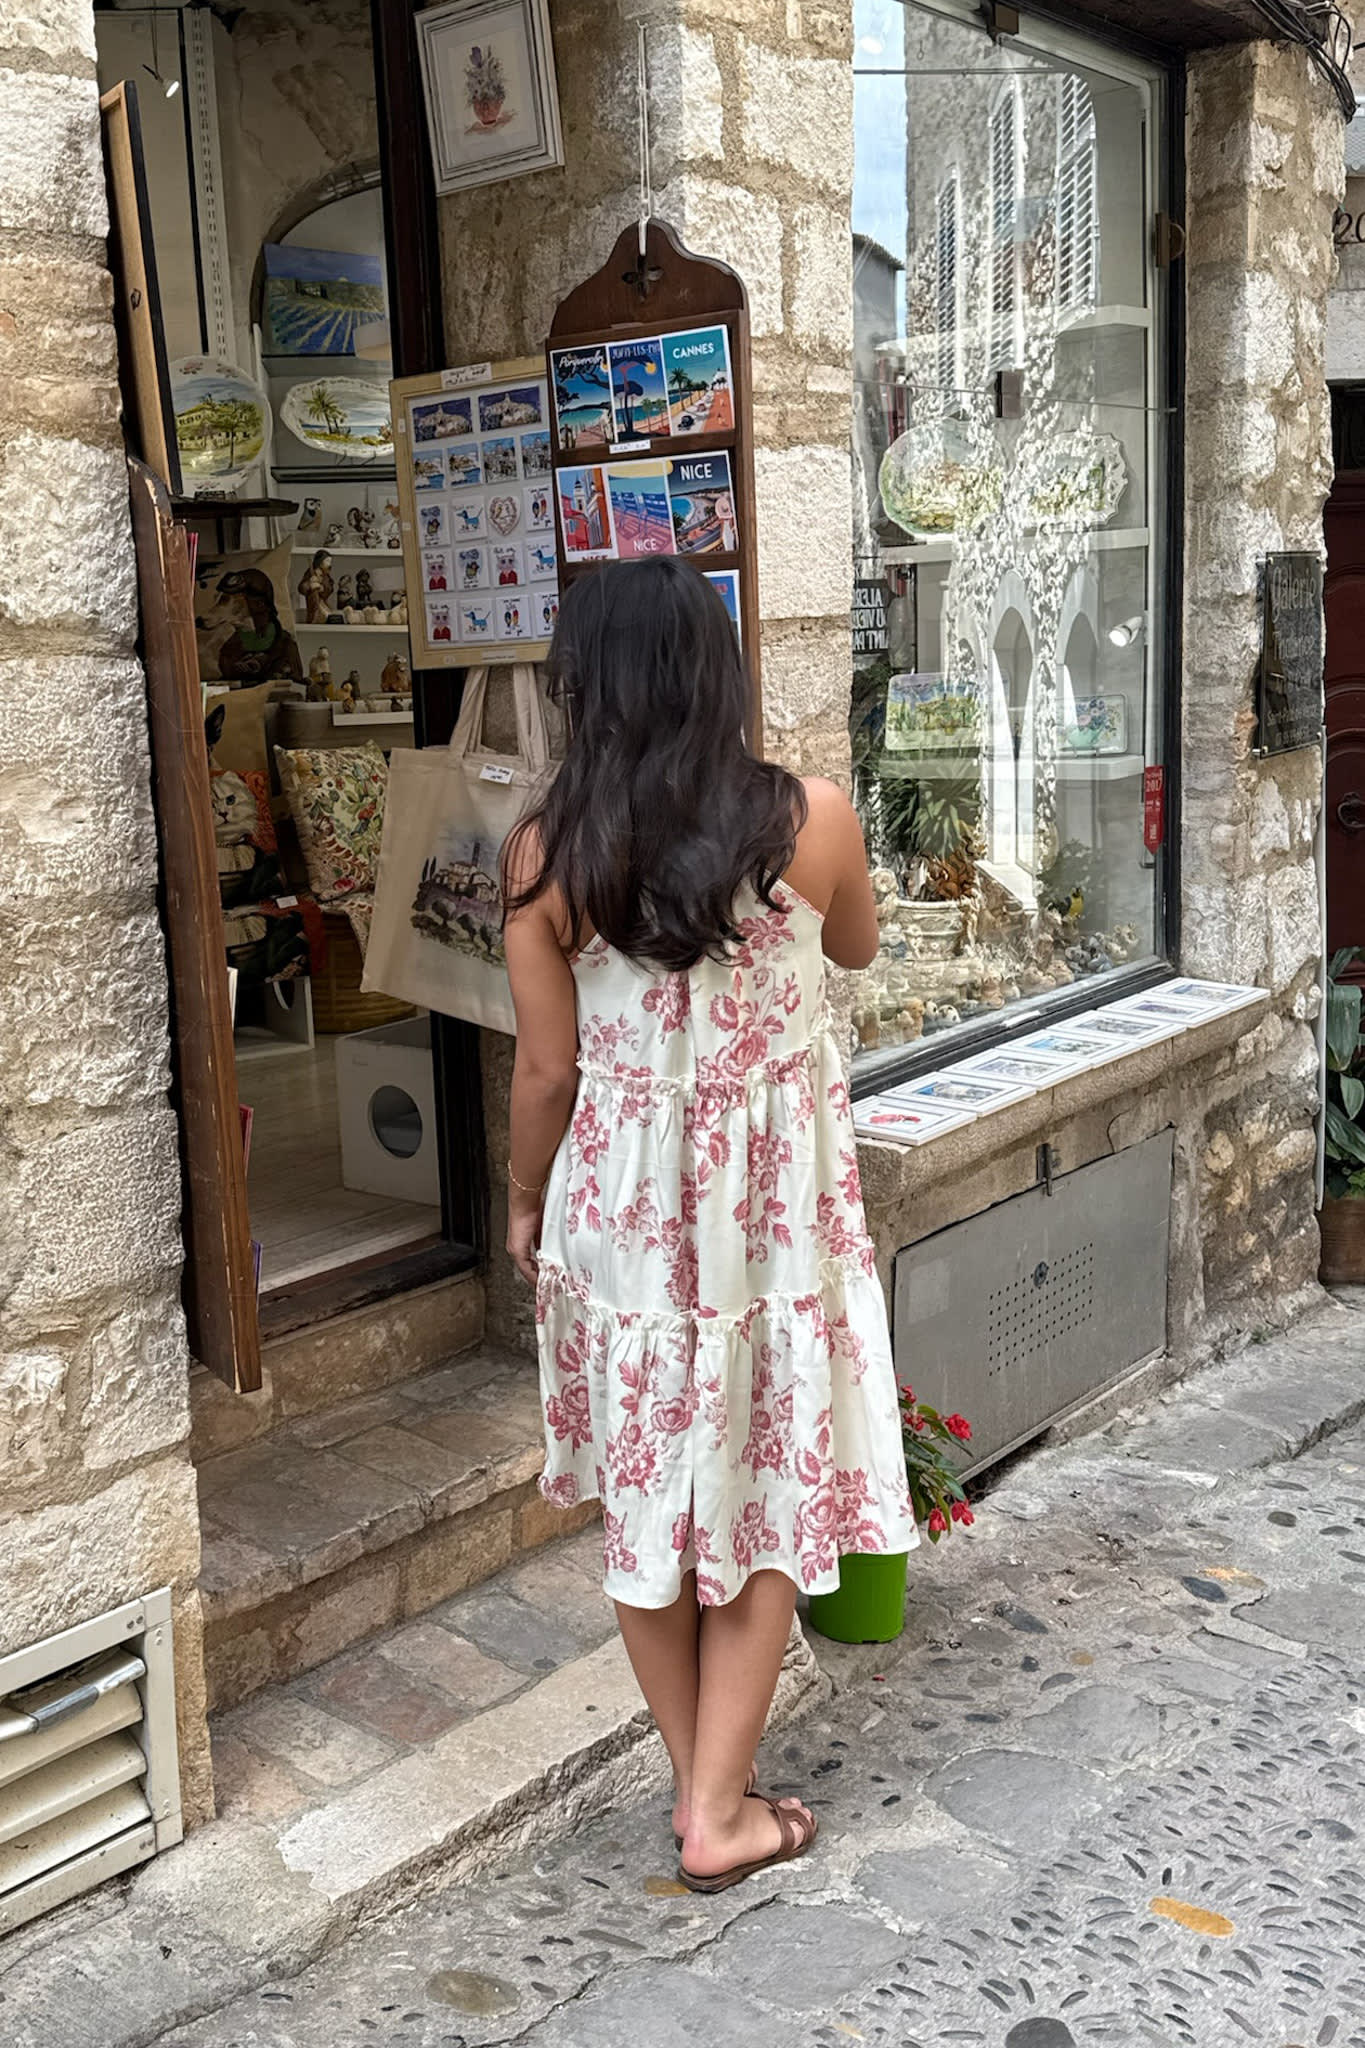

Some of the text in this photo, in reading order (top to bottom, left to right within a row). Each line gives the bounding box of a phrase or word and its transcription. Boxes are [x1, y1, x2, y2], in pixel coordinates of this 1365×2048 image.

[673, 342, 715, 360] CANNES
[680, 463, 713, 481] NICE
[633, 538, 657, 552] NICE
